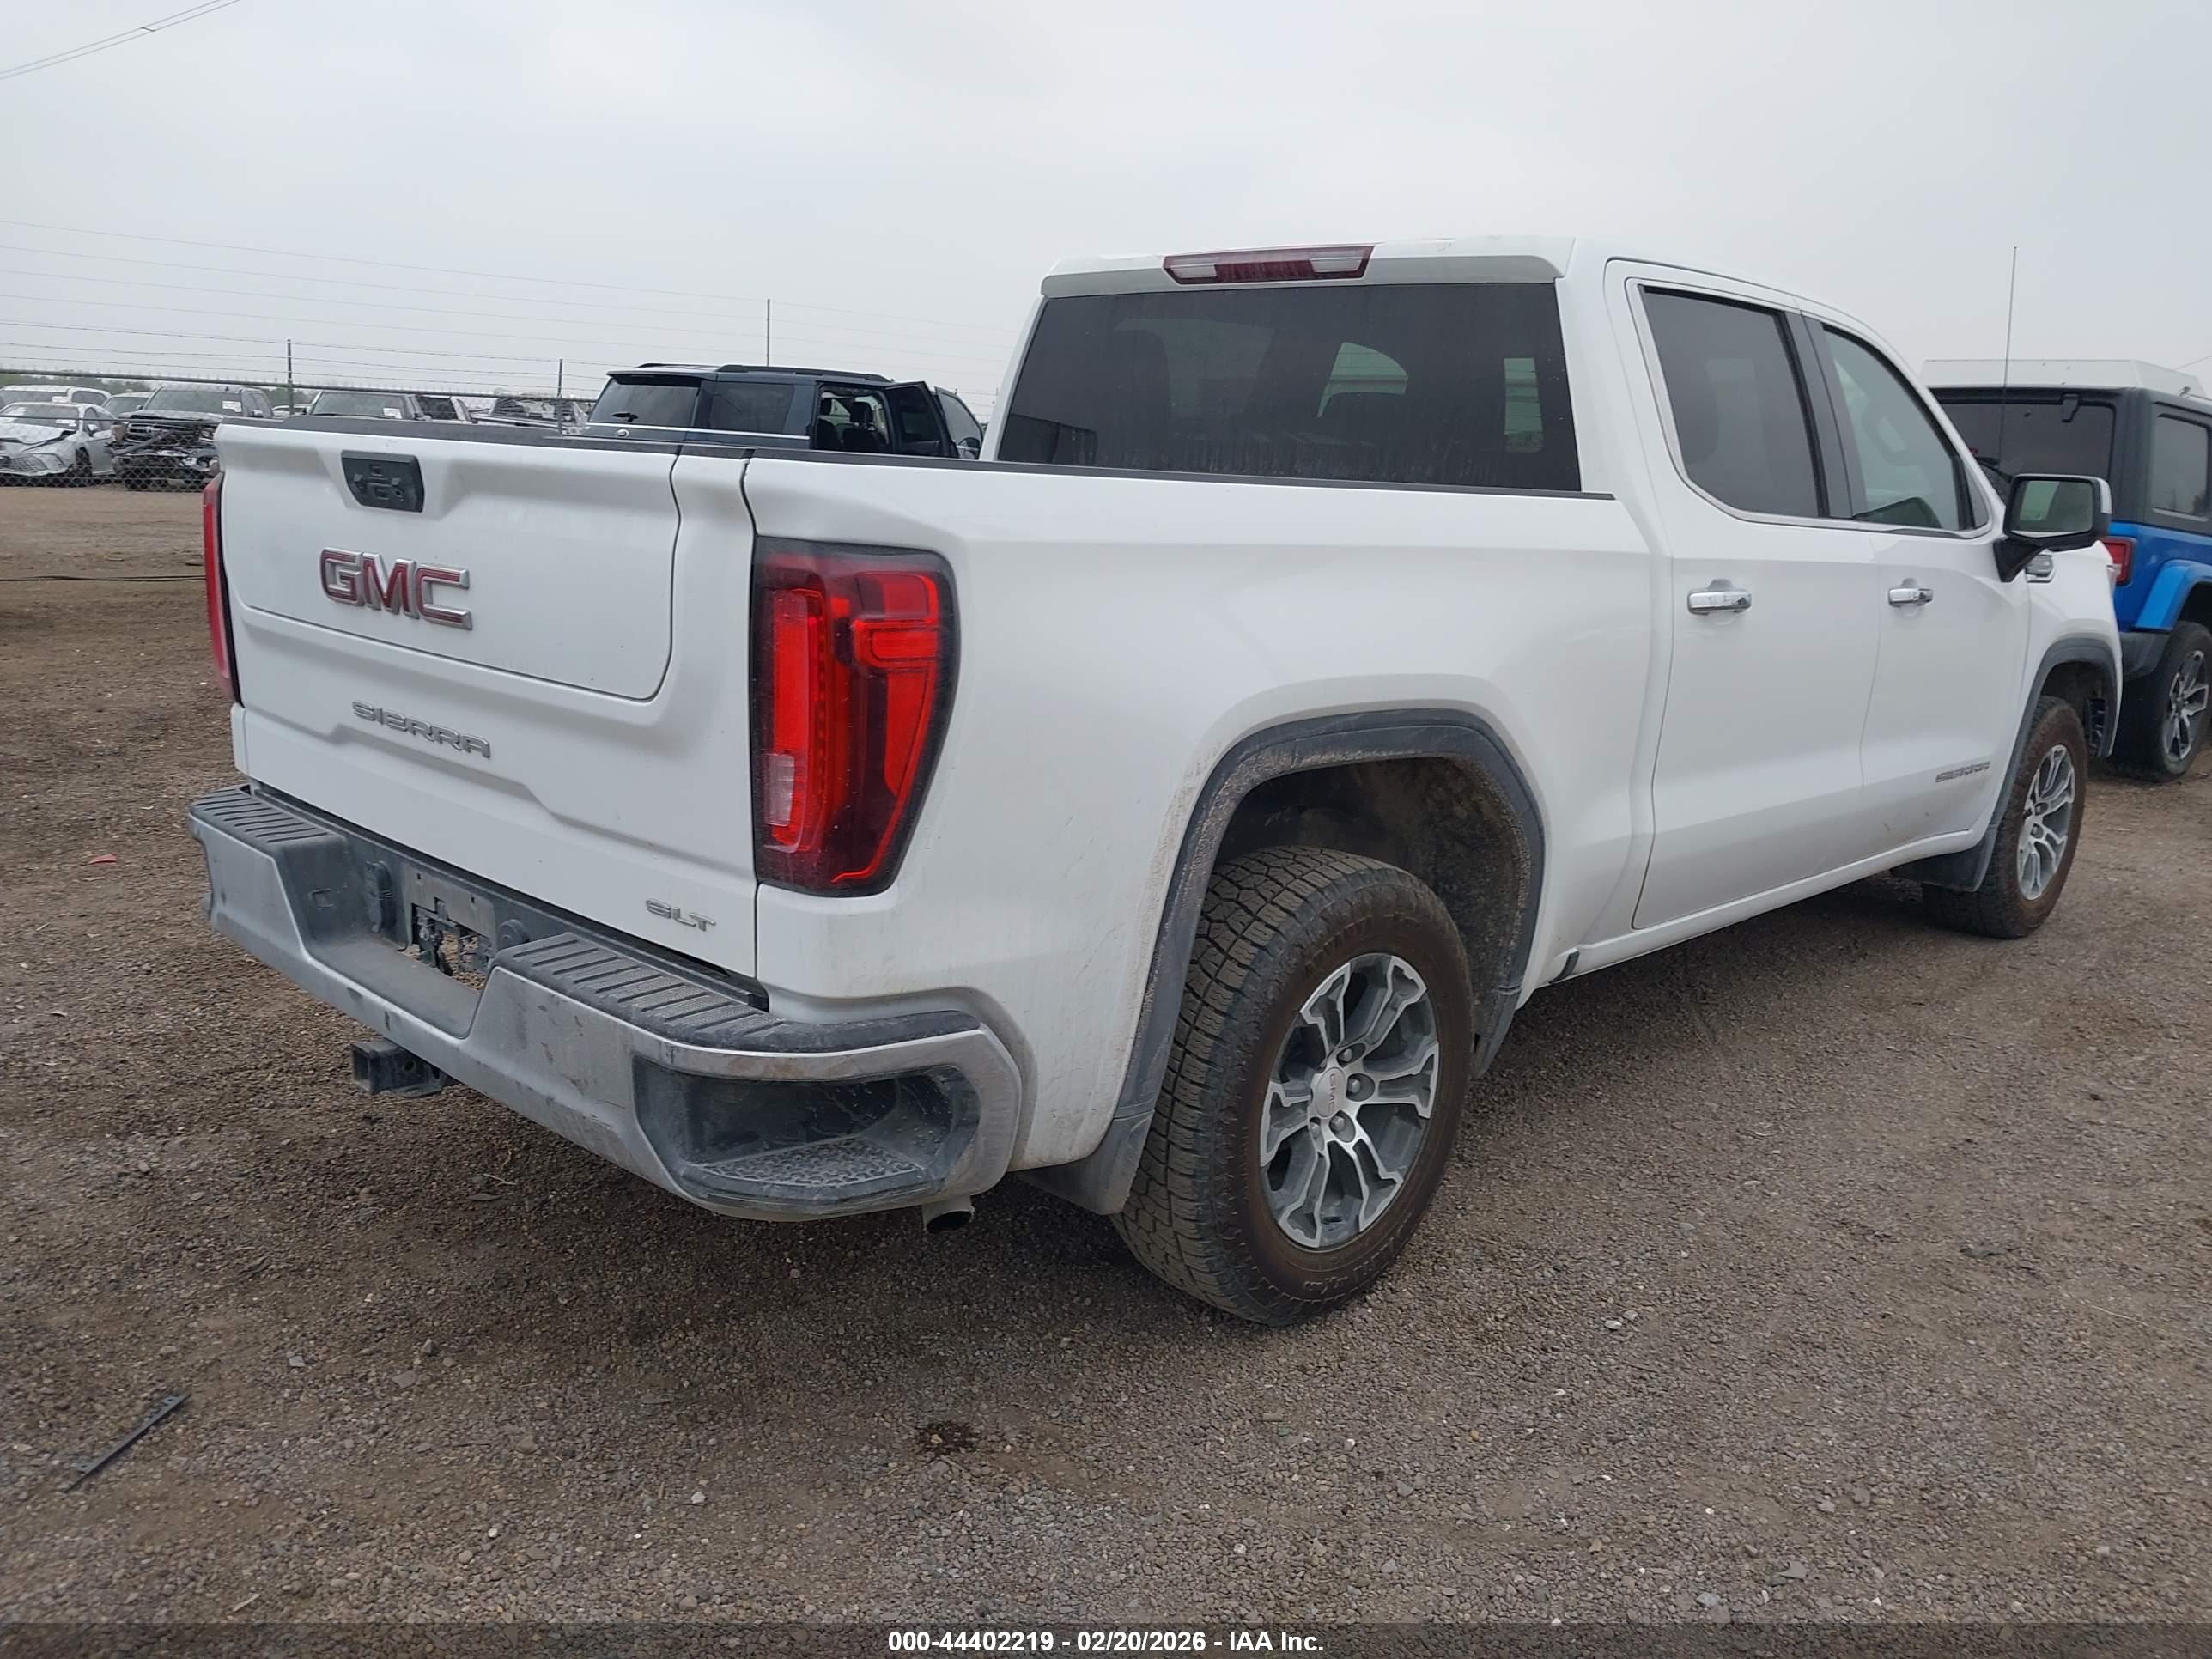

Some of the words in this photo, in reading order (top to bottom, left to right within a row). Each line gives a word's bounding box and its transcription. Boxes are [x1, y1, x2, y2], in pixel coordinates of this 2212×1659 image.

[319, 547, 472, 631] GMC
[351, 700, 491, 759] SIERRA
[645, 897, 717, 933] SLT
[1327, 1073, 1337, 1115] GMC
